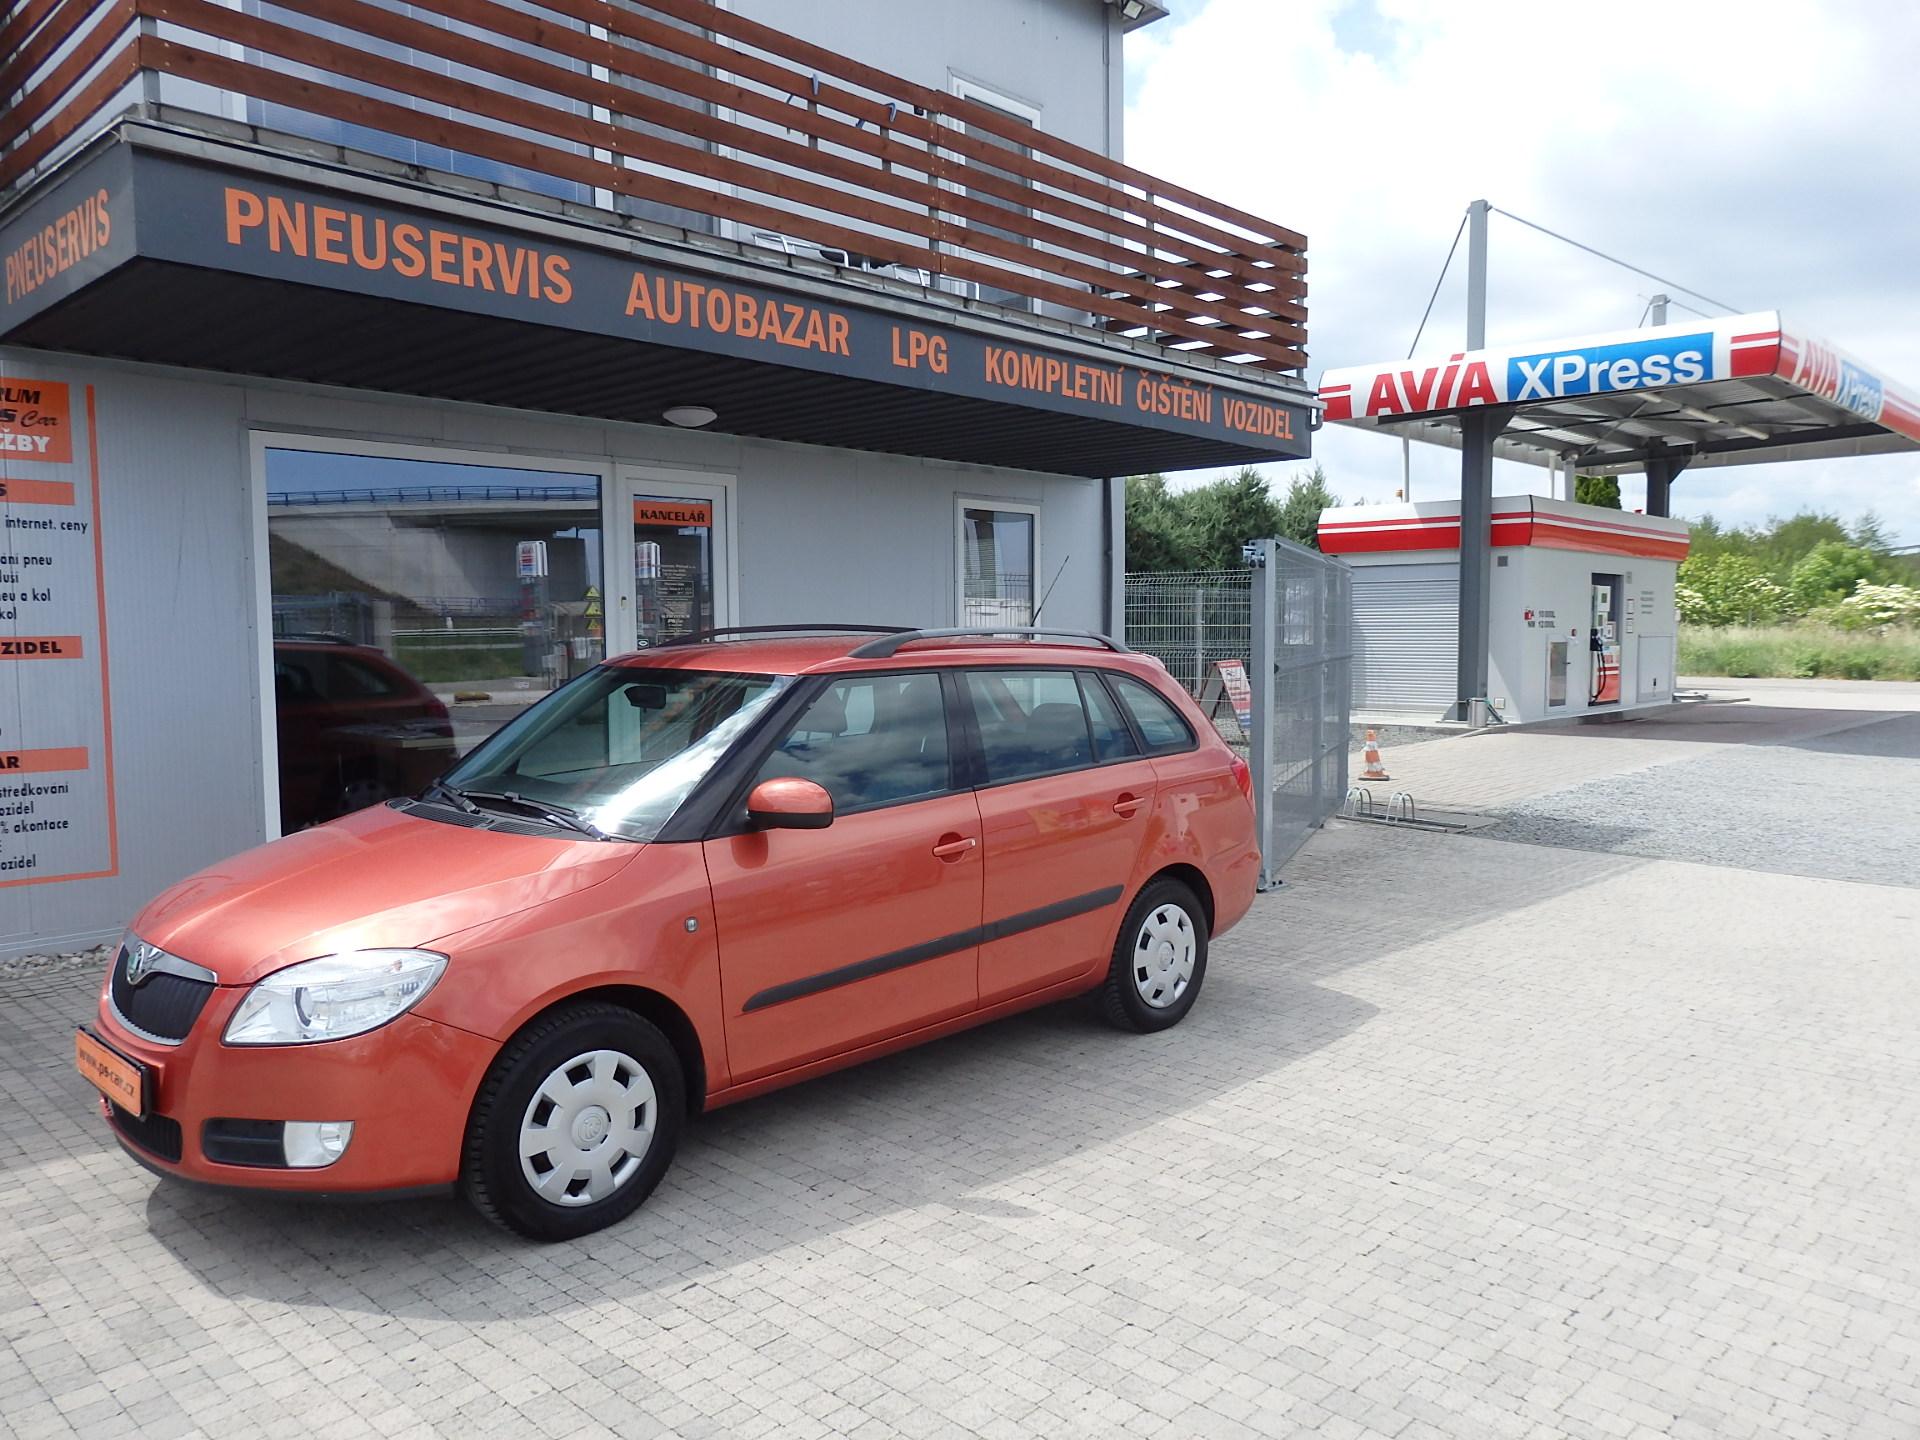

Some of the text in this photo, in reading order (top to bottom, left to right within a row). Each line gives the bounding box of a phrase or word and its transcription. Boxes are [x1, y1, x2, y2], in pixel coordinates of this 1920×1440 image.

[5, 189, 111, 301] PNEUSERVIS
[224, 187, 1295, 440] PNEUSERVIS AUTOBAZAR LPG KOMPLETNÍ ČIŠTĚNÍ VOZIDEL
[1516, 348, 1704, 401] XPress
[640, 509, 705, 522] KANCELÁŘ
[5, 514, 88, 534] internet. ceny
[23, 556, 52, 568] pneu
[20, 592, 28, 602] a
[32, 588, 51, 602] kol
[1, 641, 63, 655] ZIDEL
[13, 820, 69, 833] akontace
[0, 854, 36, 870] ozidel
